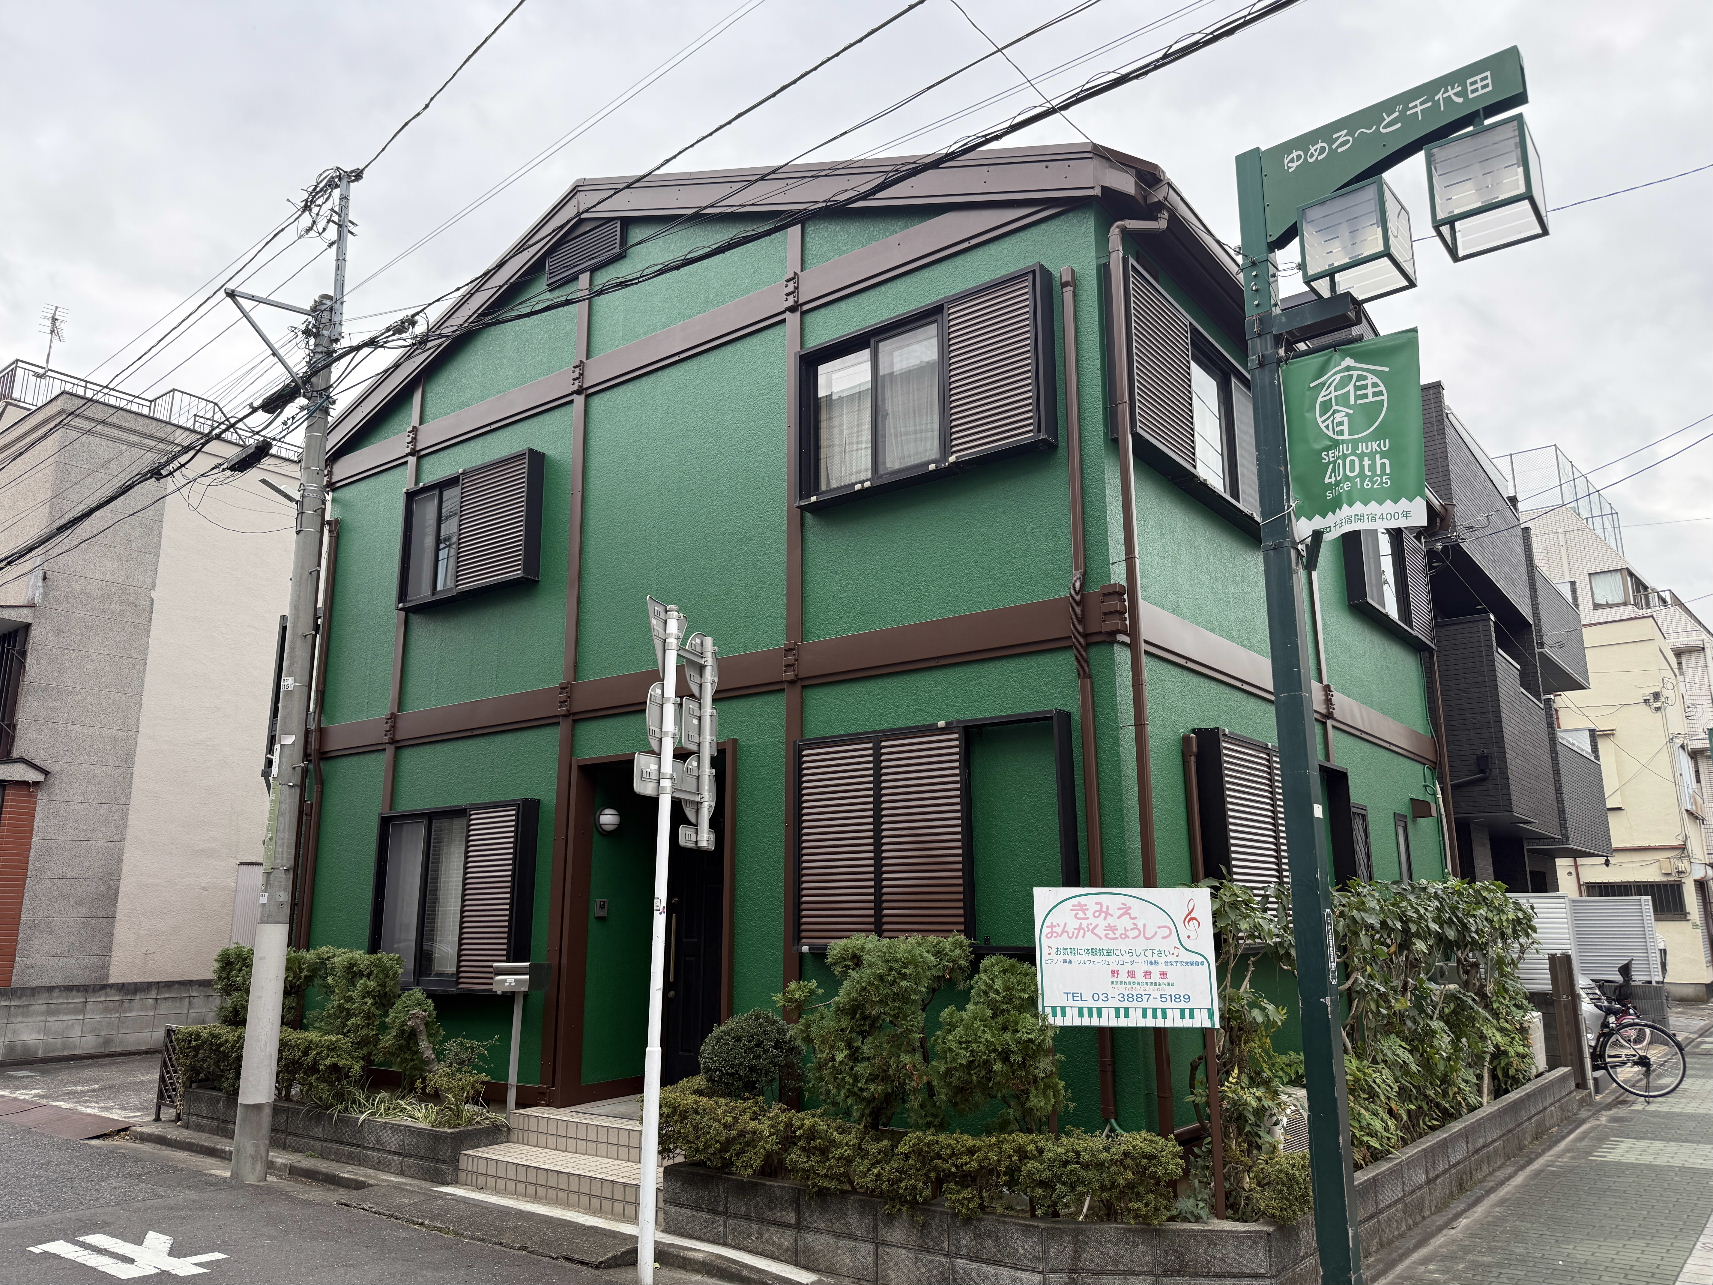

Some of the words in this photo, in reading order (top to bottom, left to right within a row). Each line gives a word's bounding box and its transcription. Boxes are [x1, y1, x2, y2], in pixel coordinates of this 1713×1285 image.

[1321, 443, 1352, 463] SENJU
[1355, 439, 1390, 454] JUKU
[1324, 453, 1391, 484] 400th
[1326, 481, 1352, 500] since
[1354, 475, 1391, 489] 1625
[1070, 901, 1138, 921] きみえ
[1045, 922, 1173, 941] おんがくきょうしつ
[1063, 992, 1088, 1003] TEL
[1091, 992, 1192, 1004] 03-3887-5189
